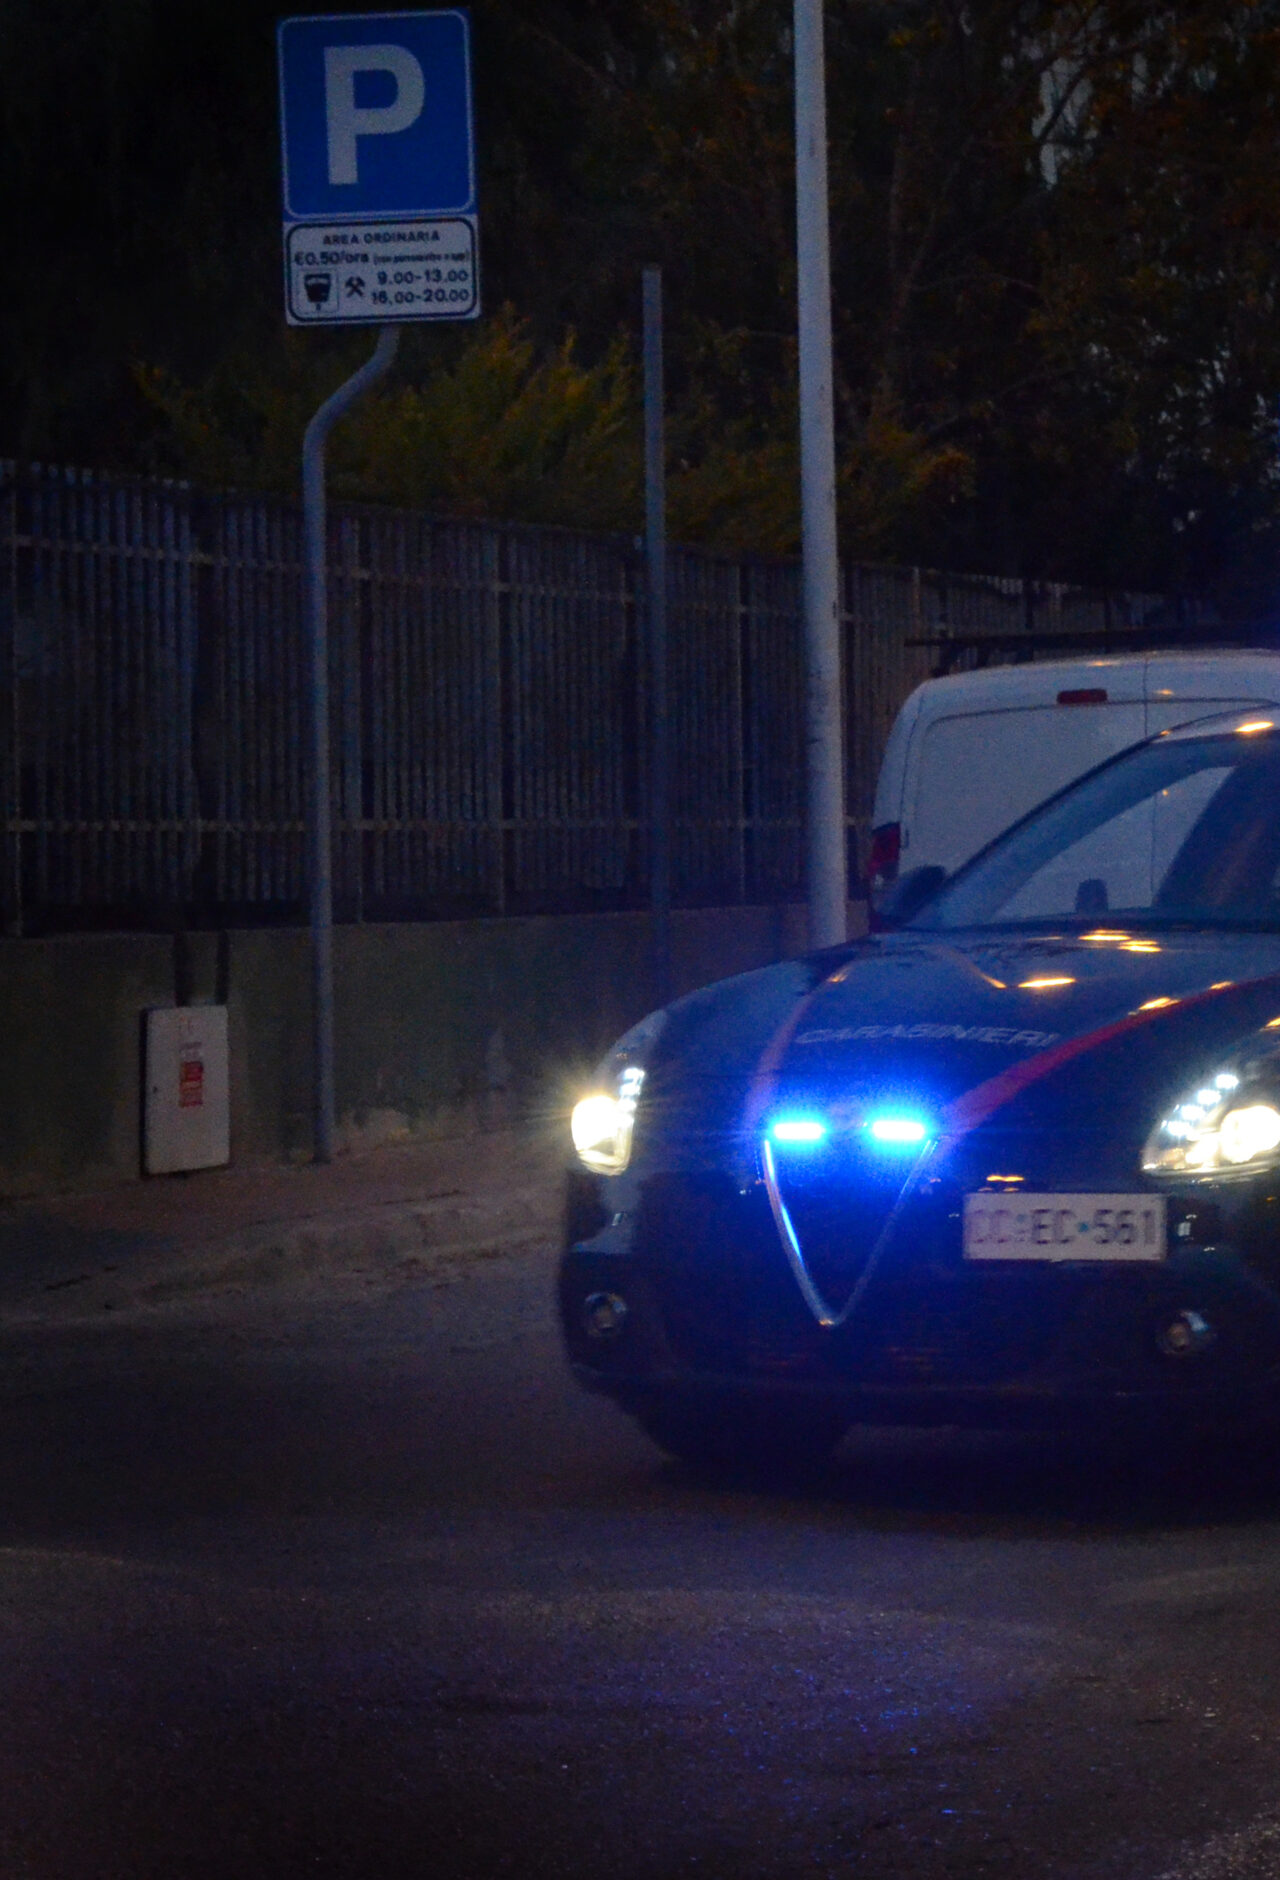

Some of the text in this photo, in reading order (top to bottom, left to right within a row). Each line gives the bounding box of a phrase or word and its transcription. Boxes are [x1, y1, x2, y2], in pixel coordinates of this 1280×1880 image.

[324, 44, 426, 185] P
[323, 230, 441, 245] AREA ORDINARIA
[376, 269, 469, 285] 9.00-13.00
